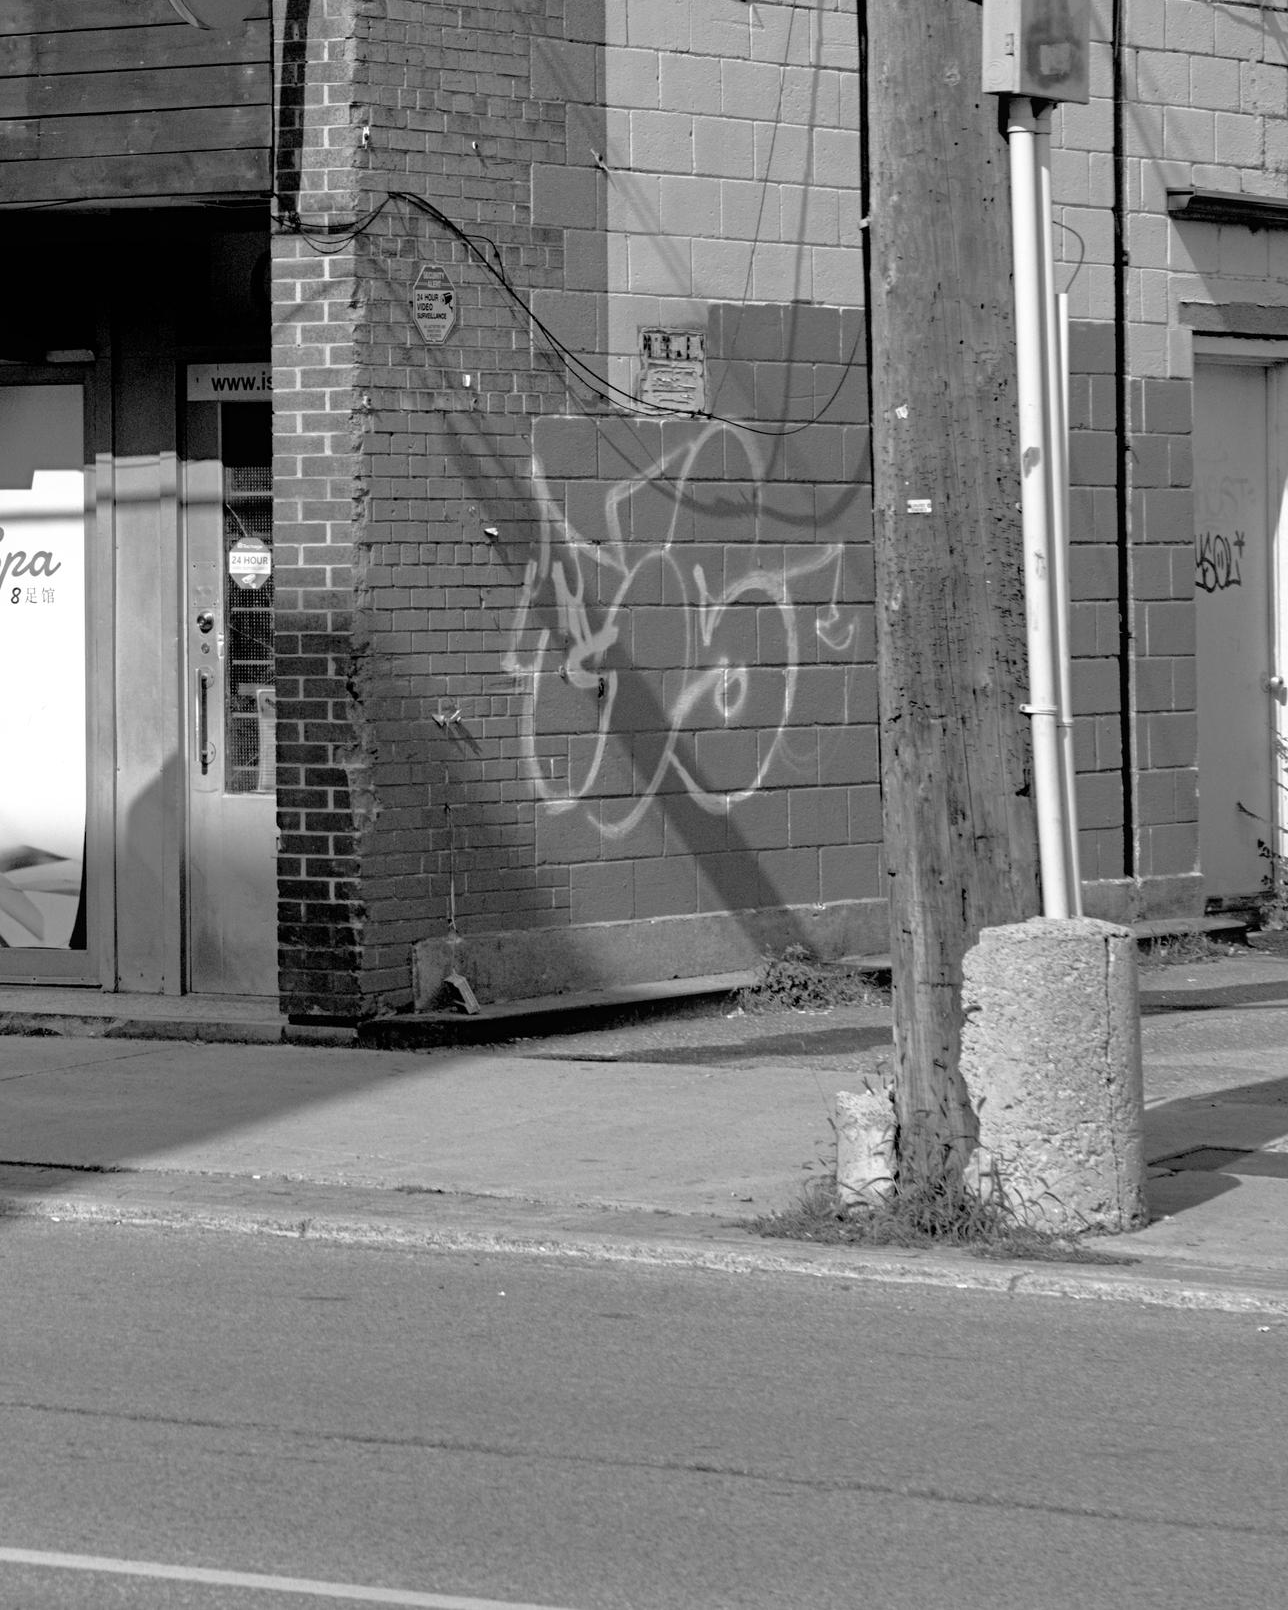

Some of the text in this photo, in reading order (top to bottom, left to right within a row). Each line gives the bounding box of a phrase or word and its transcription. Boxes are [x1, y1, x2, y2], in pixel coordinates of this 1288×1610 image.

[416, 293, 439, 301] 24 HOUR
[416, 303, 433, 311] VIDEO
[211, 371, 272, 391] www.is
[232, 556, 269, 565] 24 HOUR
